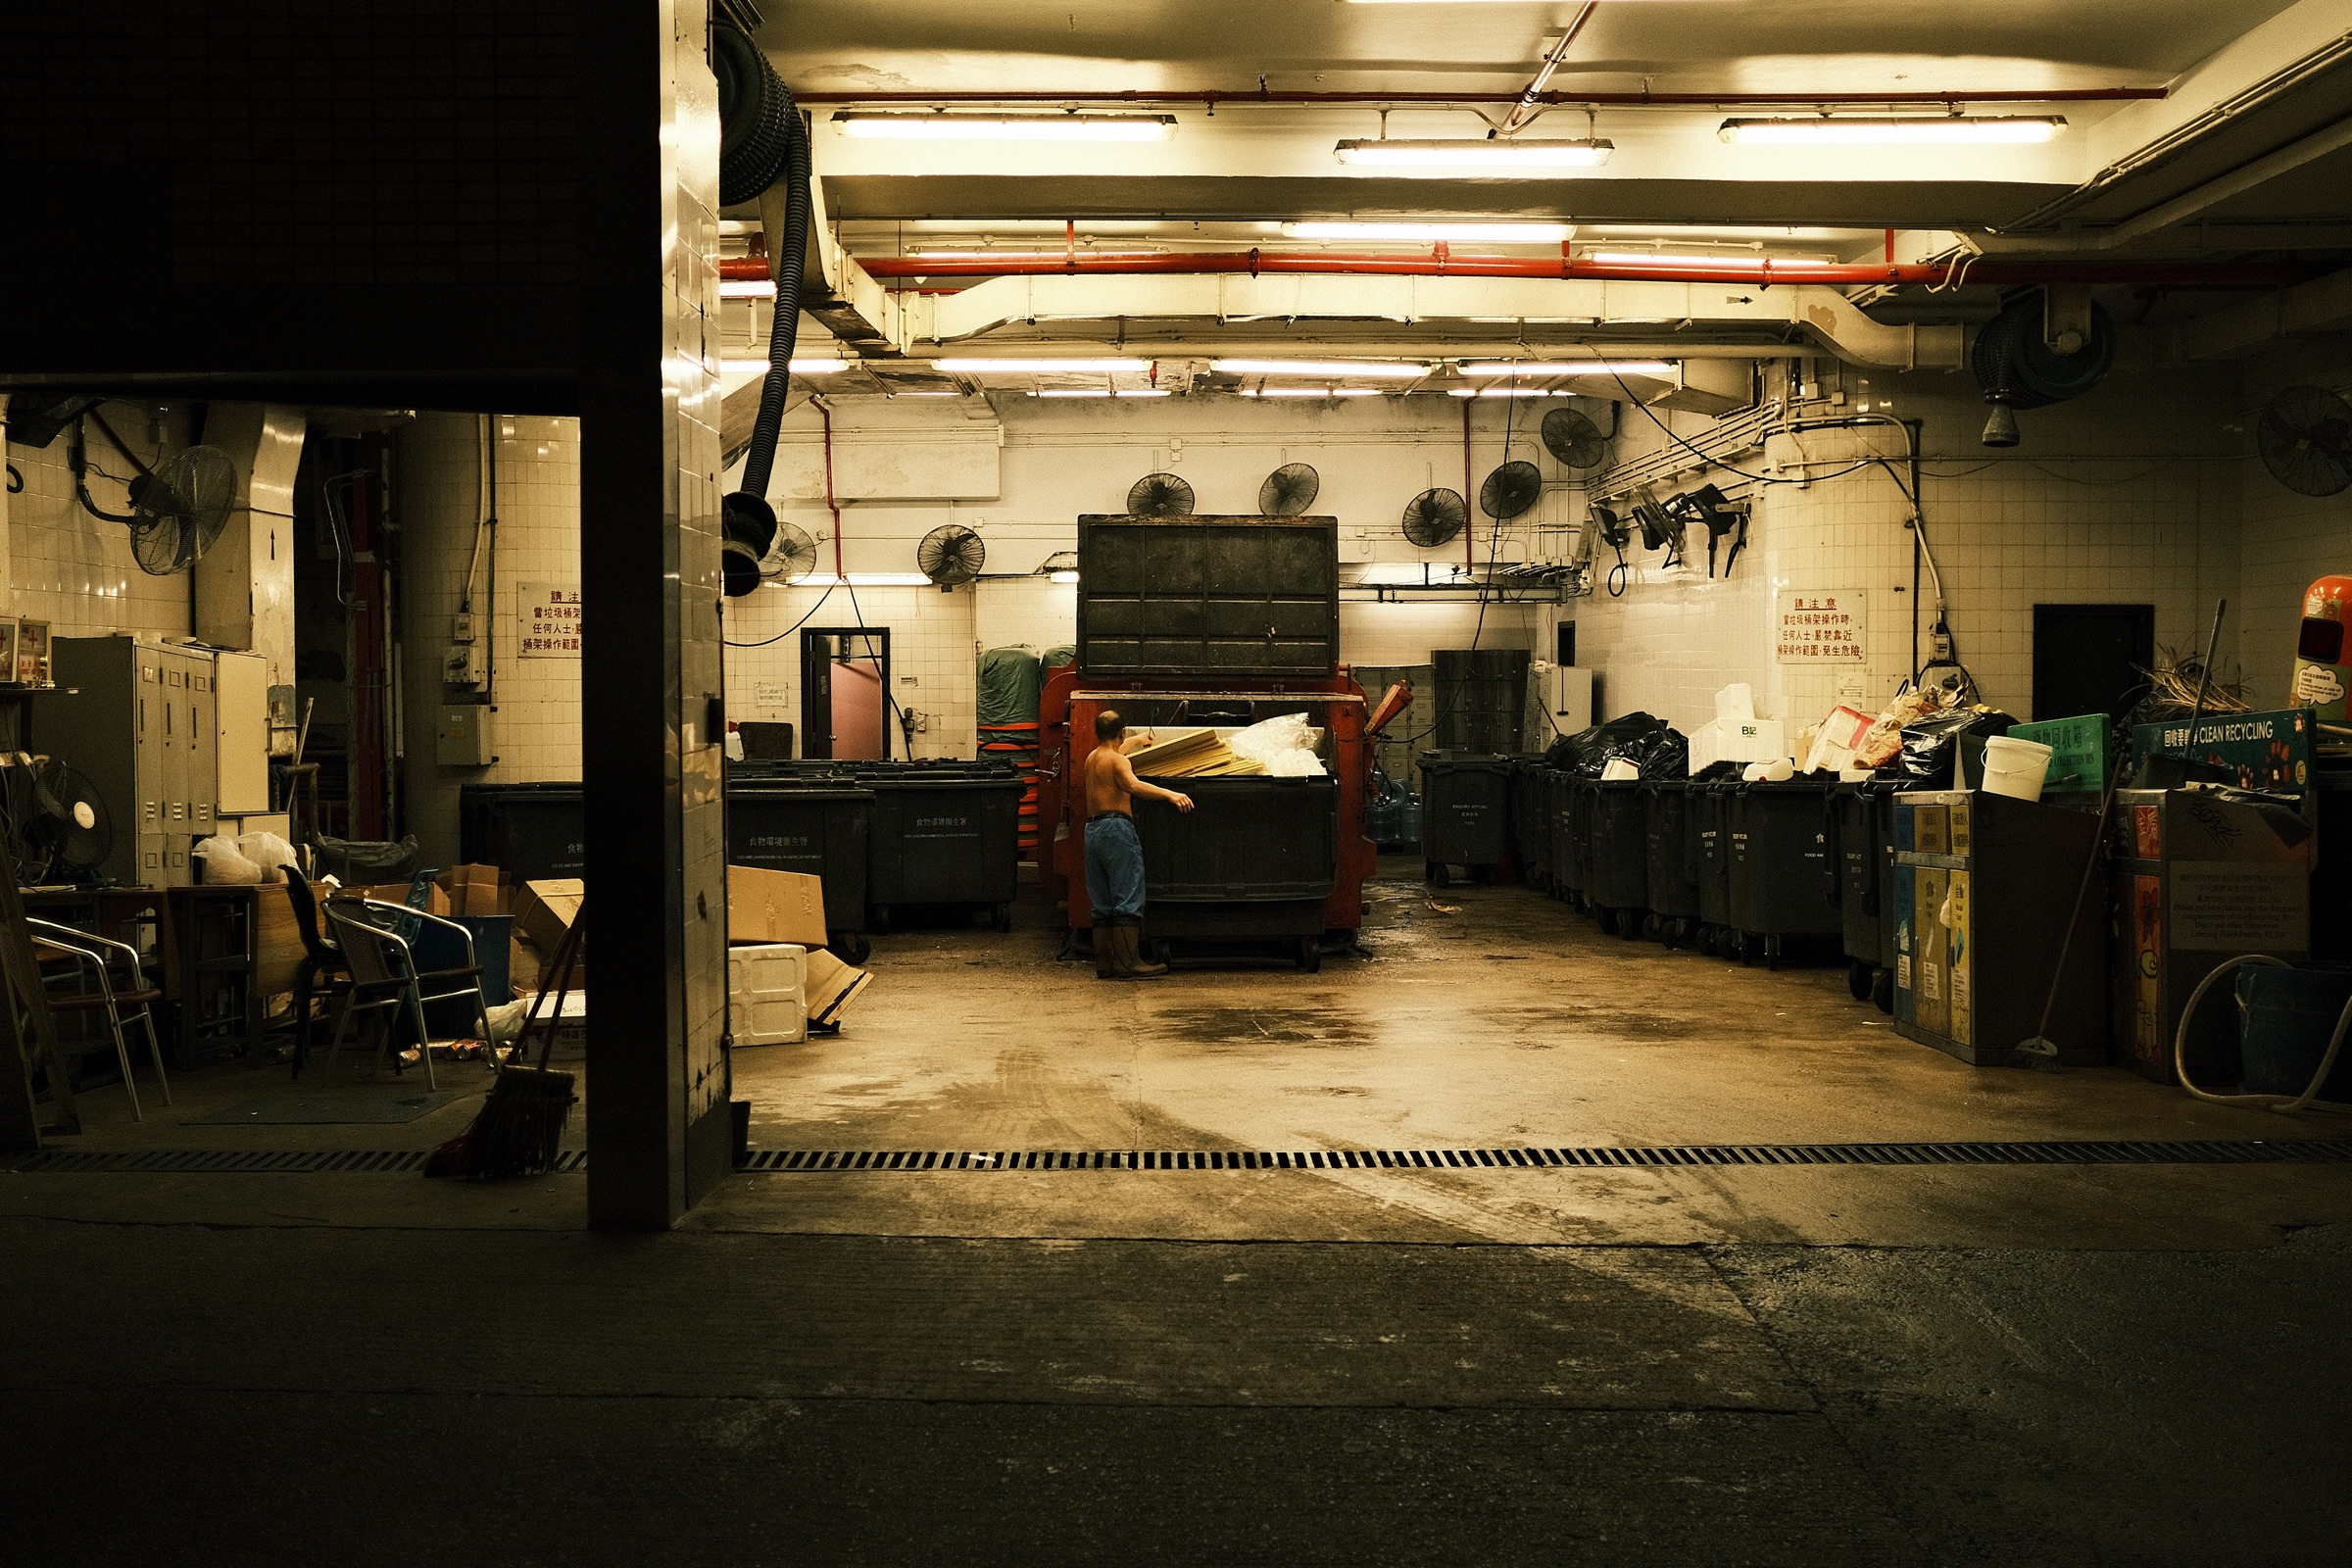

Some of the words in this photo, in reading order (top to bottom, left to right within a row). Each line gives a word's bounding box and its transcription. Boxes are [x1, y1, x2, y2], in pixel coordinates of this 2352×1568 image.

[1794, 598, 1837, 609] 請注意
[2199, 726, 2224, 744] CLEAN
[2225, 720, 2274, 742] RECYCLING
